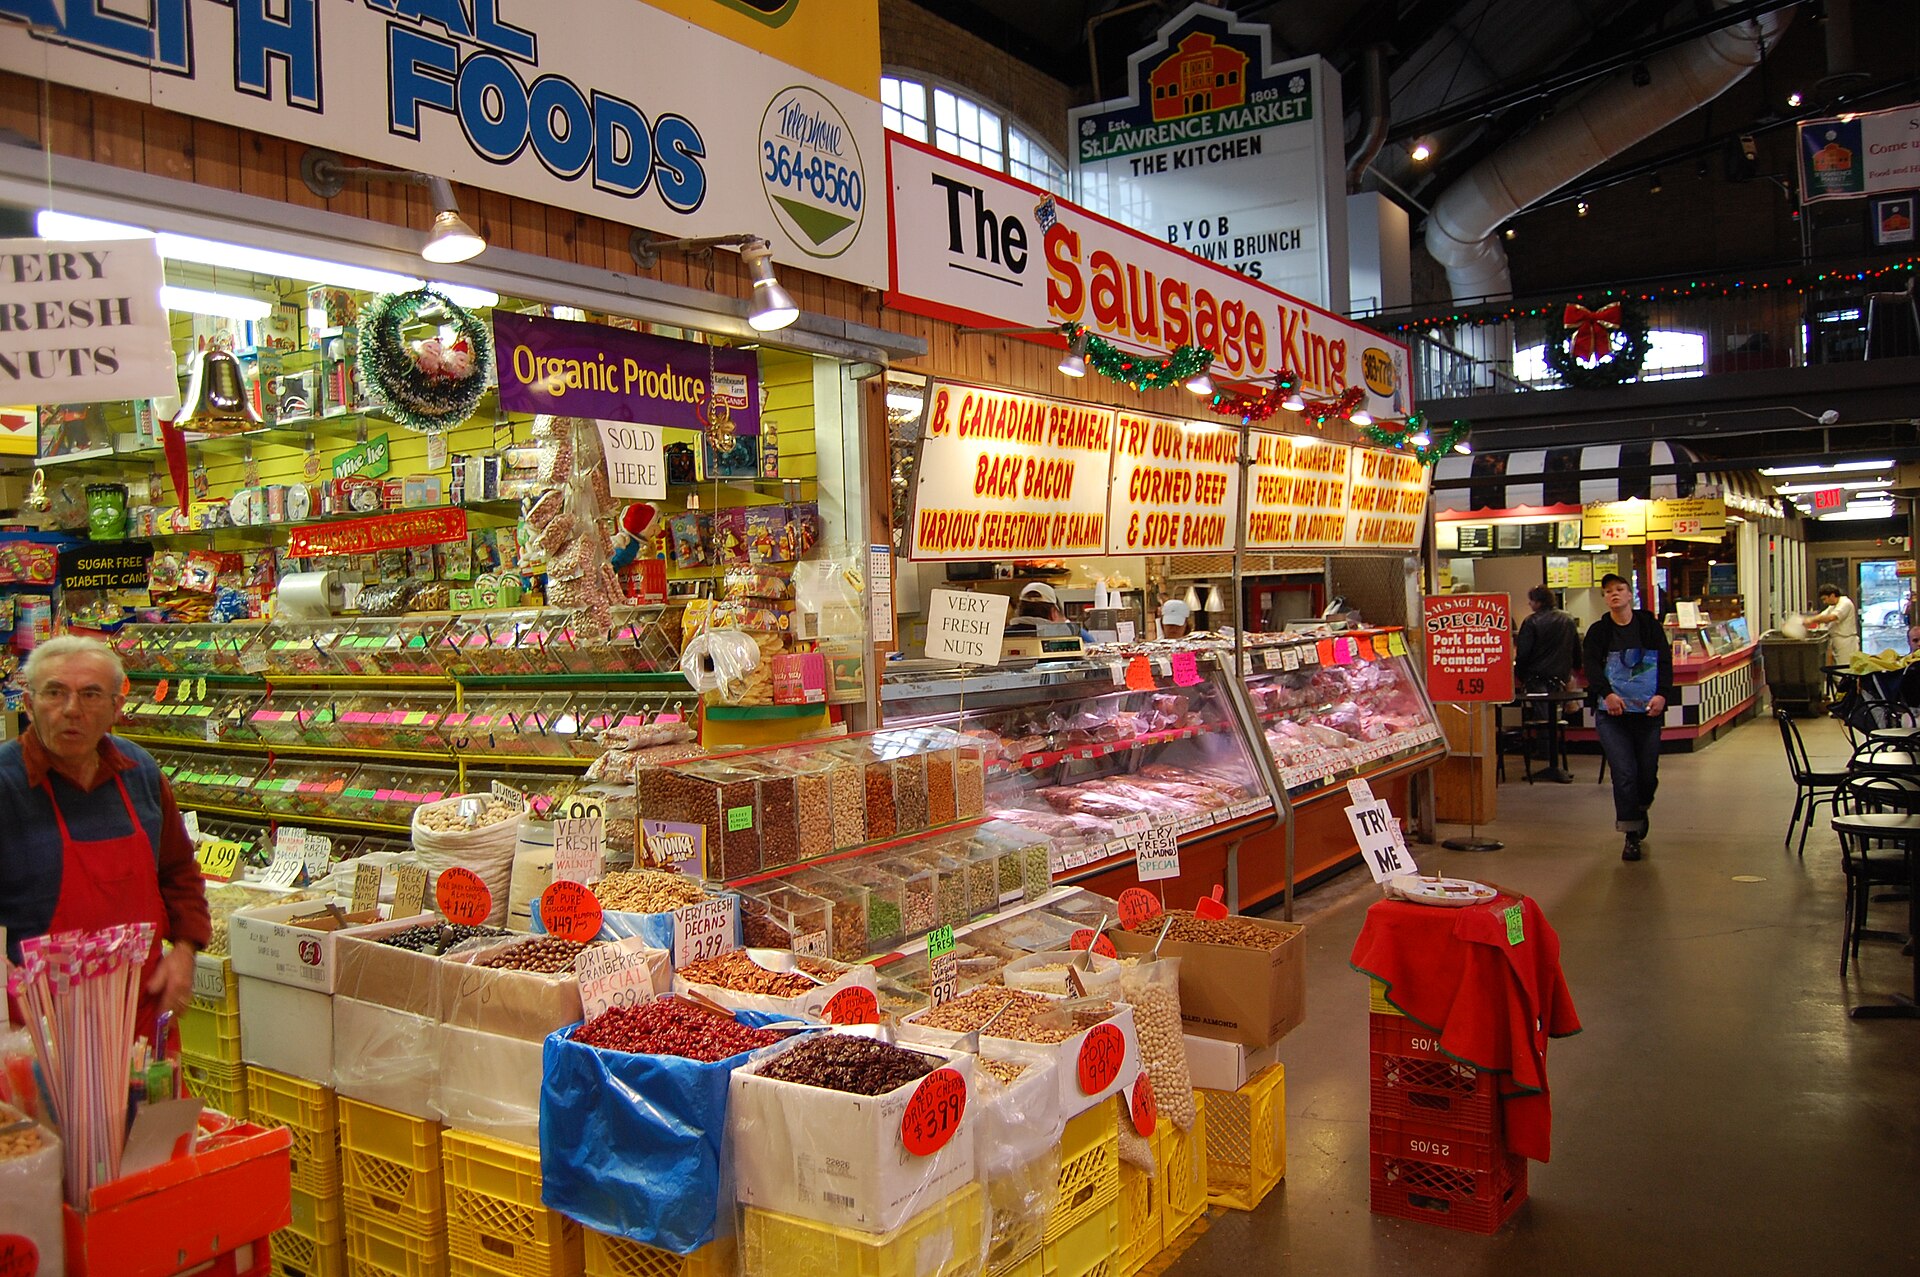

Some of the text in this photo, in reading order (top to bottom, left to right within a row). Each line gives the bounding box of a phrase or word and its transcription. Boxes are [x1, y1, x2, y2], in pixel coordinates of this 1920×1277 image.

[1251, 88, 1279, 103] 1803
[386, 20, 707, 215] FOODS
[1217, 97, 1307, 132] MARKET
[778, 97, 843, 157] Telephone
[1130, 135, 1262, 177] THE KITCHEN
[1869, 140, 1908, 155] Come
[931, 172, 1029, 275] The
[1234, 229, 1301, 258] BRUNCH
[1044, 221, 1348, 396] Sausage King
[512, 344, 705, 405] Organic Produce
[932, 389, 1110, 450] B. CANADIAN PEAMEAL
[607, 428, 655, 453] SOLD
[1118, 418, 1238, 464] TRY OUR FAMOUS
[335, 442, 386, 479] Mike Ike
[1257, 436, 1346, 474] ALL OUR SAUSAGES ARE
[614, 462, 658, 487] HERE
[974, 454, 1075, 500] BACK BACON
[1361, 452, 1423, 485] TRY OUR FAMOUS
[1129, 467, 1227, 505] CORNED BEEF
[1256, 475, 1343, 509] FRESHLY MADE ON THE
[1351, 483, 1426, 515] HOME MADE TURKEY
[1814, 488, 1841, 510] EXIT
[919, 511, 1103, 550] VARIOUS SELECTIONS OF SALAMI
[1127, 513, 1226, 548] & SIDE BACON
[1248, 512, 1346, 543] PREMISES. NO ADDITIVES
[1363, 518, 1382, 543] HAM
[77, 556, 143, 571] SUGAR FREE
[65, 571, 149, 588] DIABETIC CAND
[947, 595, 990, 614] VERY
[1424, 598, 1506, 617] SAUSAGE KING
[941, 616, 990, 636] FRESH
[1427, 611, 1508, 634] SPECIAL
[943, 638, 984, 656] NUTS
[1433, 633, 1501, 646] Pork Backs
[1433, 646, 1455, 654] rolled
[1457, 646, 1465, 654] in
[1484, 645, 1503, 654] meal
[1433, 653, 1485, 666] Peameal
[1456, 678, 1485, 695] 4.59
[557, 819, 599, 836] VERY
[1356, 807, 1390, 837] TRY
[305, 836, 328, 844] RESH
[556, 836, 600, 852] FRESH
[1136, 826, 1173, 842] VERY
[1136, 837, 1175, 851] FRESH
[203, 845, 236, 868] 1.99
[276, 850, 303, 860] SPECIAL
[304, 843, 329, 852] RAZIL
[651, 836, 693, 863] WONKA
[672, 852, 688, 862] BAR
[1139, 849, 1177, 861] ALMONDS
[556, 860, 595, 870] WALNUT
[1138, 860, 1179, 872] SPECIAL
[1374, 846, 1402, 874] ME
[402, 883, 421, 893] NUTS
[448, 869, 478, 884] SPECIAL
[552, 883, 586, 898] SPECIAL
[560, 893, 582, 905] PURE
[675, 897, 734, 923] VERY FRESH
[684, 914, 727, 940] PECANS
[928, 926, 951, 943] VERY
[579, 942, 622, 970] DRIED
[929, 938, 956, 959] FRESH
[582, 969, 648, 1000] SPECIAL
[831, 987, 865, 1011] SPECIAL
[1202, 1017, 1238, 1029] ALMONDS
[1082, 1029, 1121, 1069] TODAY
[1084, 1026, 1111, 1049] SPECIAL
[915, 1071, 949, 1103] SPECIAL
[902, 1091, 934, 1133] DRIED
[1410, 1139, 1450, 1157] 25/05
